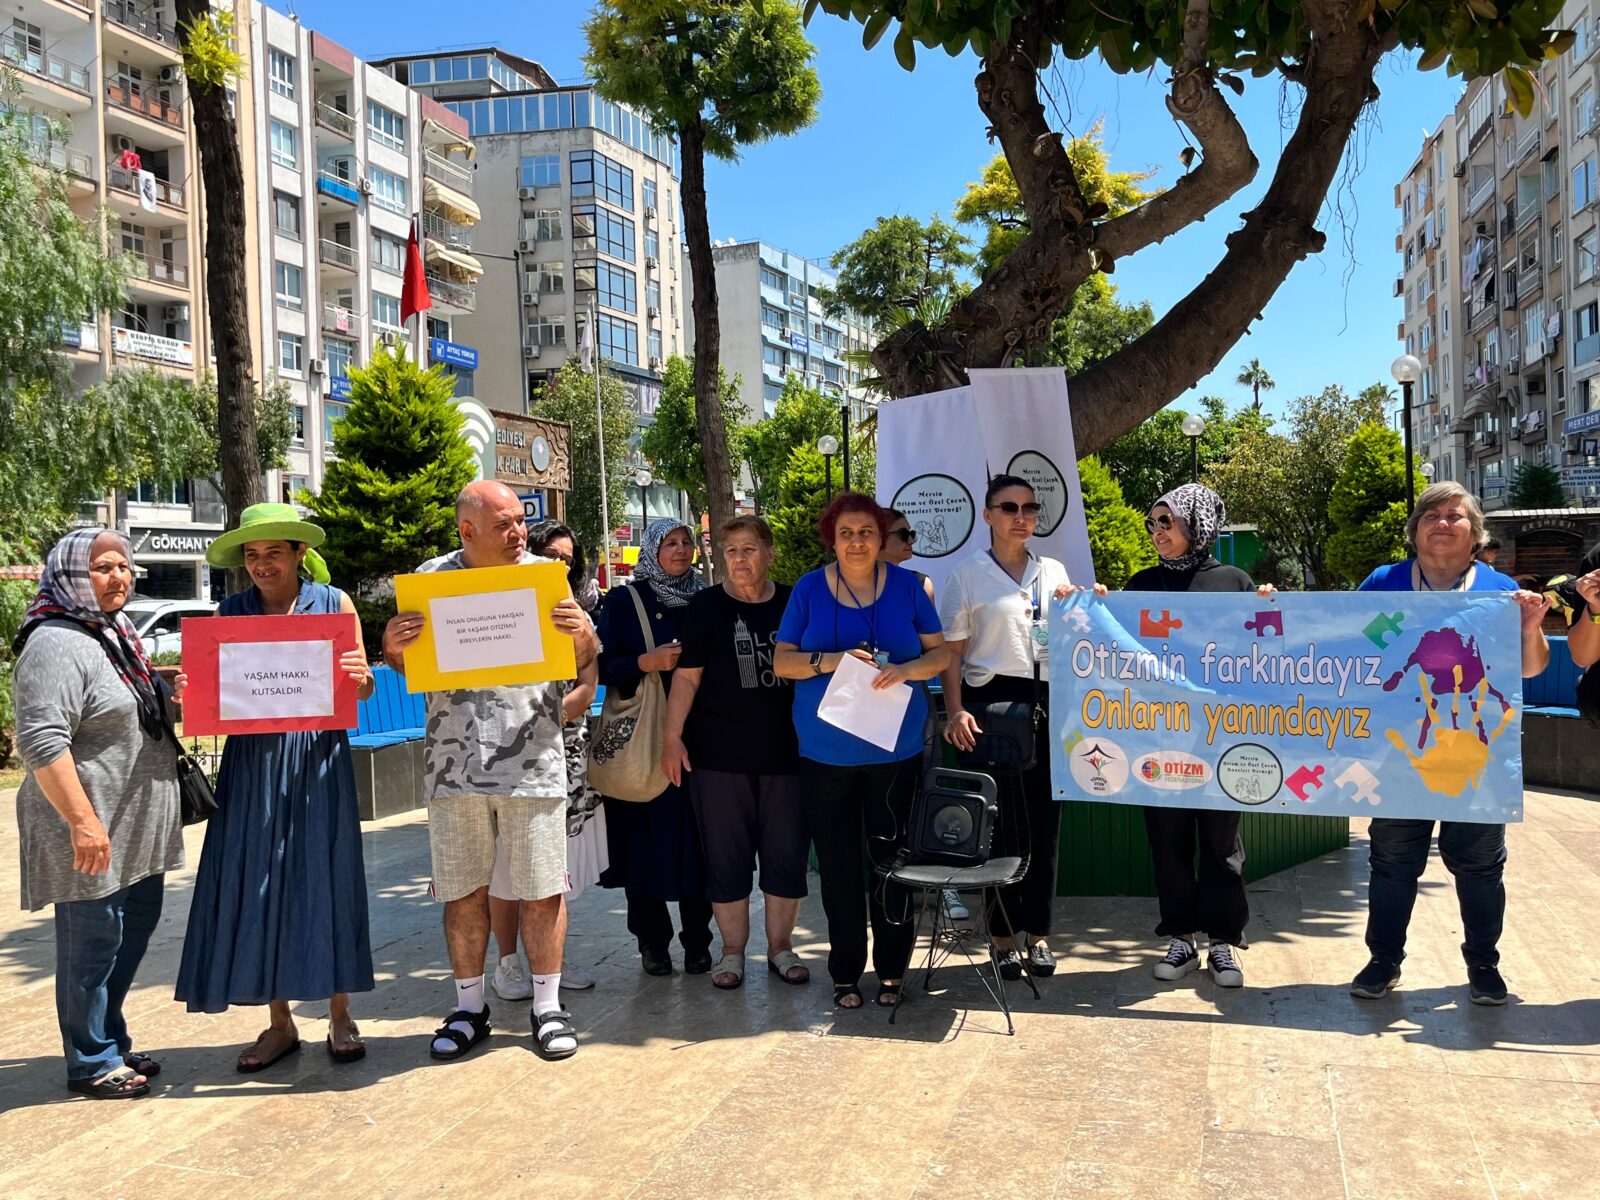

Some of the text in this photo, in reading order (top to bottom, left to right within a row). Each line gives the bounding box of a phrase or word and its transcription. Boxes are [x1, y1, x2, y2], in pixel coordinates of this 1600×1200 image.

[1567, 418, 1584, 432] MERT
[496, 427, 526, 447] EDİYESİ
[918, 490, 943, 498] Mersin
[928, 498, 944, 506] Özel
[946, 496, 968, 505] Çocuk
[524, 501, 536, 518] D
[151, 533, 202, 550] GÖKHAN
[446, 611, 525, 625] İNSAN ONURUNA YAKIŞAN
[456, 627, 467, 635] BİR
[468, 625, 489, 634] YAŞAM
[459, 634, 492, 645] BİREYLERİN
[1071, 639, 1383, 698] Otizmin farkındayız
[244, 670, 309, 682] YAŞAM HAKKI
[251, 686, 303, 696] KUTSALDIR
[1081, 687, 1371, 750] Onların yanındayız
[1164, 760, 1204, 776] OTİZM
